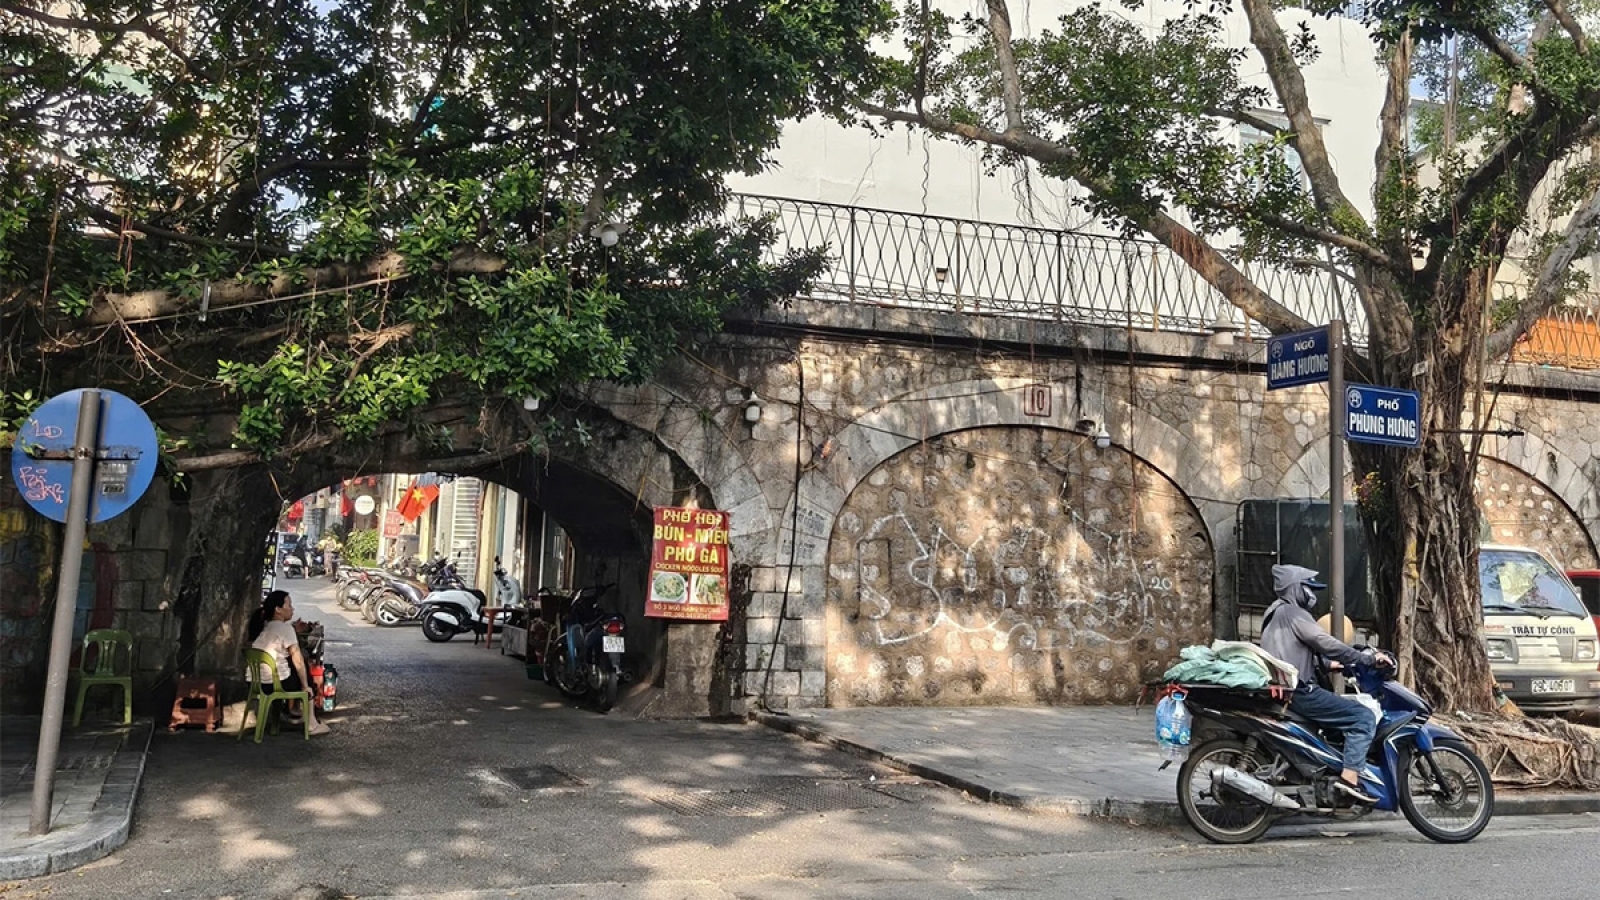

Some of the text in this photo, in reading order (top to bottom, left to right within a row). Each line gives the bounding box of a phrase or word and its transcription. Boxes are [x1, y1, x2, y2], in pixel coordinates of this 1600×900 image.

[1294, 337, 1315, 352] NGÕ
[1271, 353, 1329, 380] HÀNG HƯƠNG
[1377, 397, 1400, 411] PHỐ
[1349, 409, 1416, 438] PHÙNG HƯNG
[654, 522, 685, 541] BÚN
[664, 542, 719, 564] PHỞ GÀ
[655, 562, 681, 571] CHICKEN
[1512, 625, 1534, 637] TRẬT
[1537, 626, 1549, 636] TỰ
[1550, 624, 1576, 634] CÔNG
